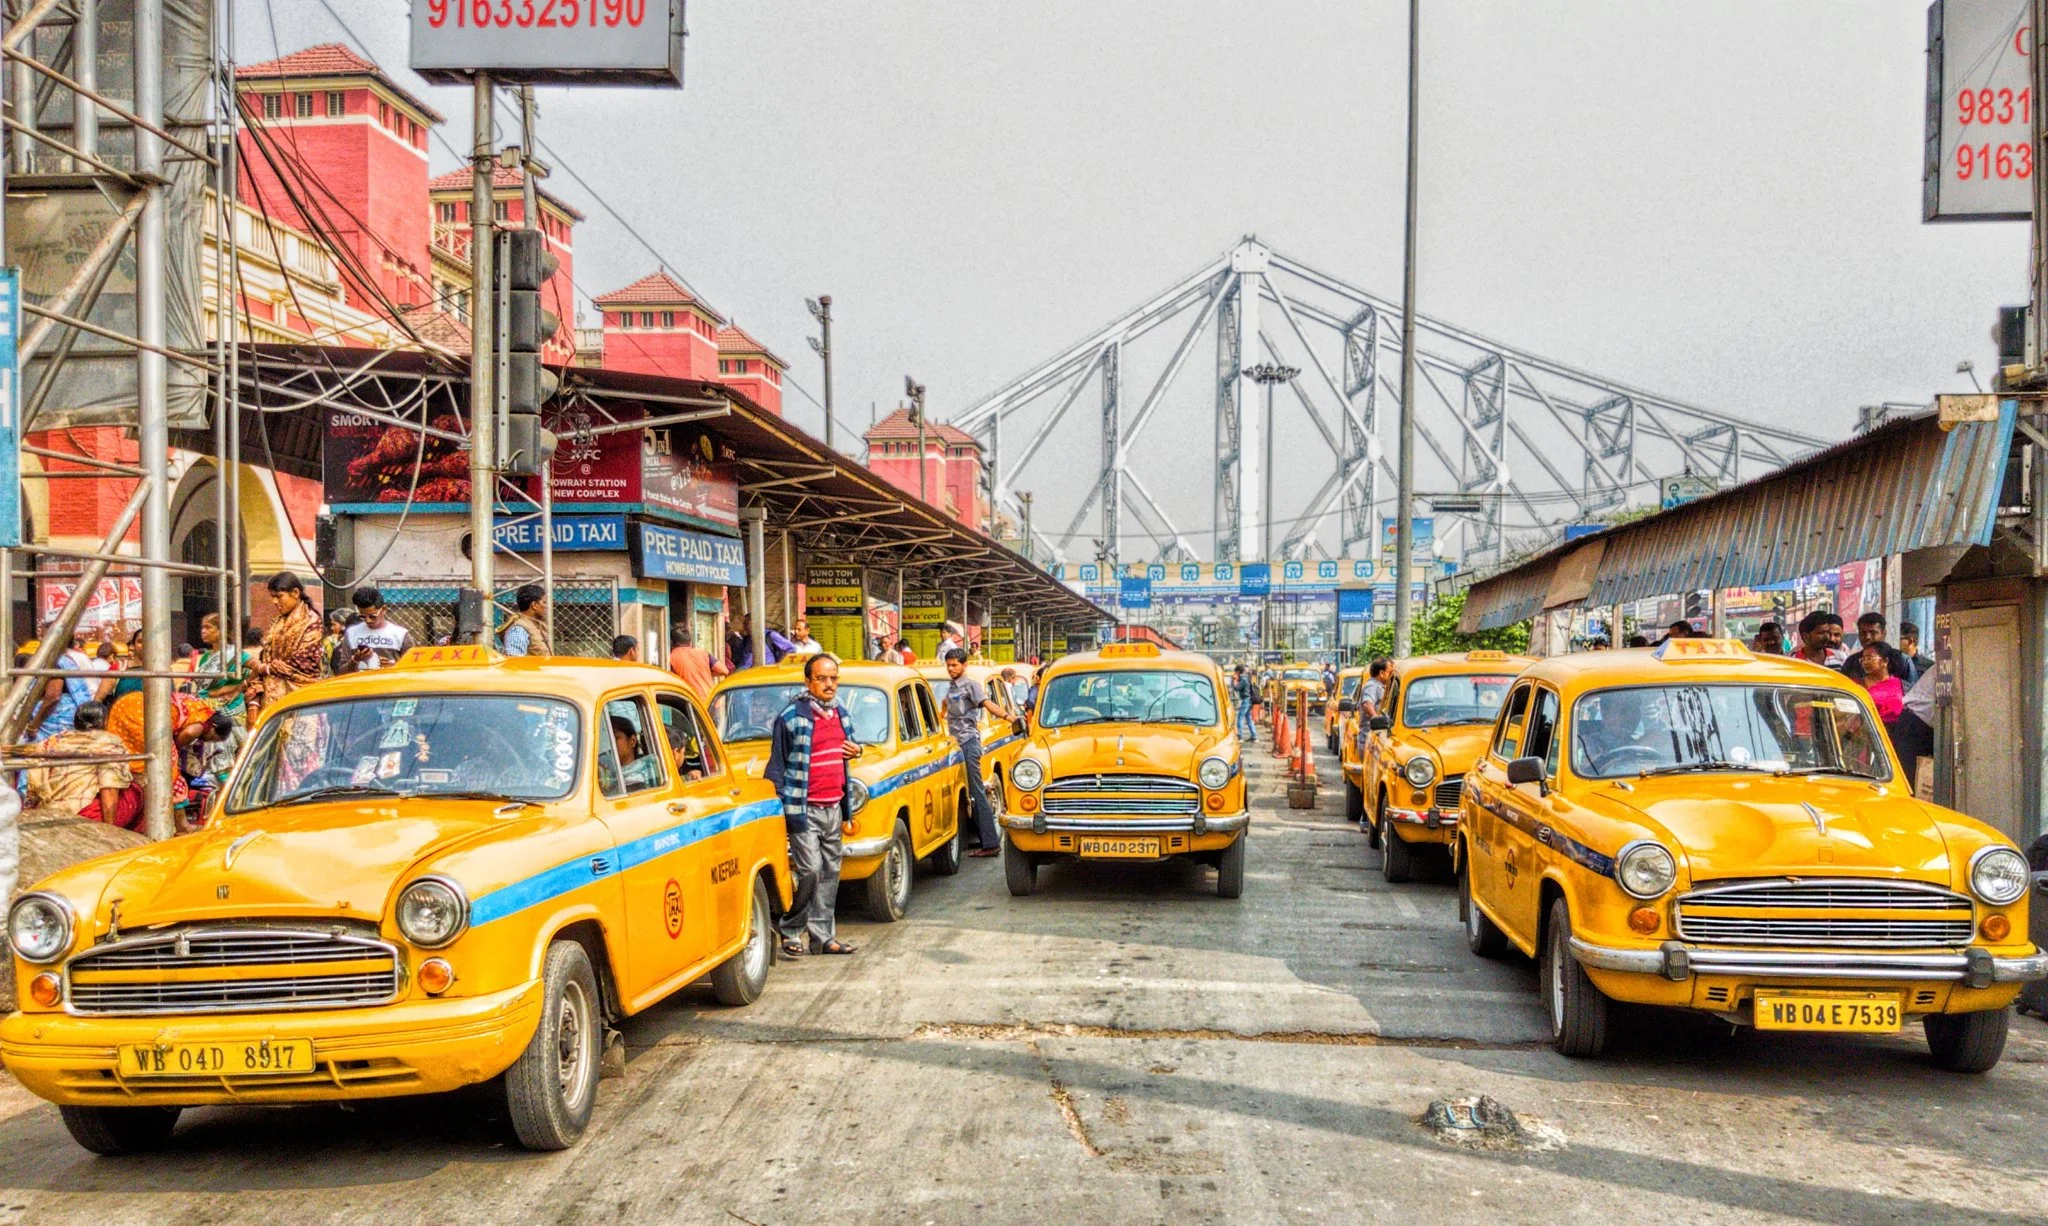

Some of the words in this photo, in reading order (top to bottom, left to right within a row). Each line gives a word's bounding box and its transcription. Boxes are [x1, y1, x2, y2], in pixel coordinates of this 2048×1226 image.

[428, 0, 645, 28] 9163325190
[550, 479, 587, 487] OWRAH
[588, 479, 627, 487] STATION
[554, 489, 585, 498] NEW
[586, 489, 620, 498] COMPLEX
[495, 524, 530, 544] PRE
[579, 522, 616, 542] TAXI
[645, 531, 678, 557] PRE
[680, 540, 712, 562] PAID
[714, 542, 743, 566] TAXI
[665, 560, 695, 577] HOWRAH
[694, 565, 708, 578] CITY
[708, 566, 730, 580] POLICE
[810, 569, 834, 577] SUNO
[836, 569, 853, 577] TOH
[810, 578, 834, 586] APNE
[836, 578, 850, 586] DIL
[851, 578, 860, 586] KI
[836, 594, 859, 603] cozi
[1936, 613, 1951, 629] PRE
[357, 635, 393, 645] adidas
[1107, 645, 1151, 654] TAXI
[1676, 642, 1738, 654] TAXI
[411, 648, 479, 662] TAXI
[1848, 1005, 1897, 1026] 7539
[134, 1046, 167, 1071] WB
[179, 1046, 225, 1070] 04D
[244, 1044, 295, 1069] 8917
